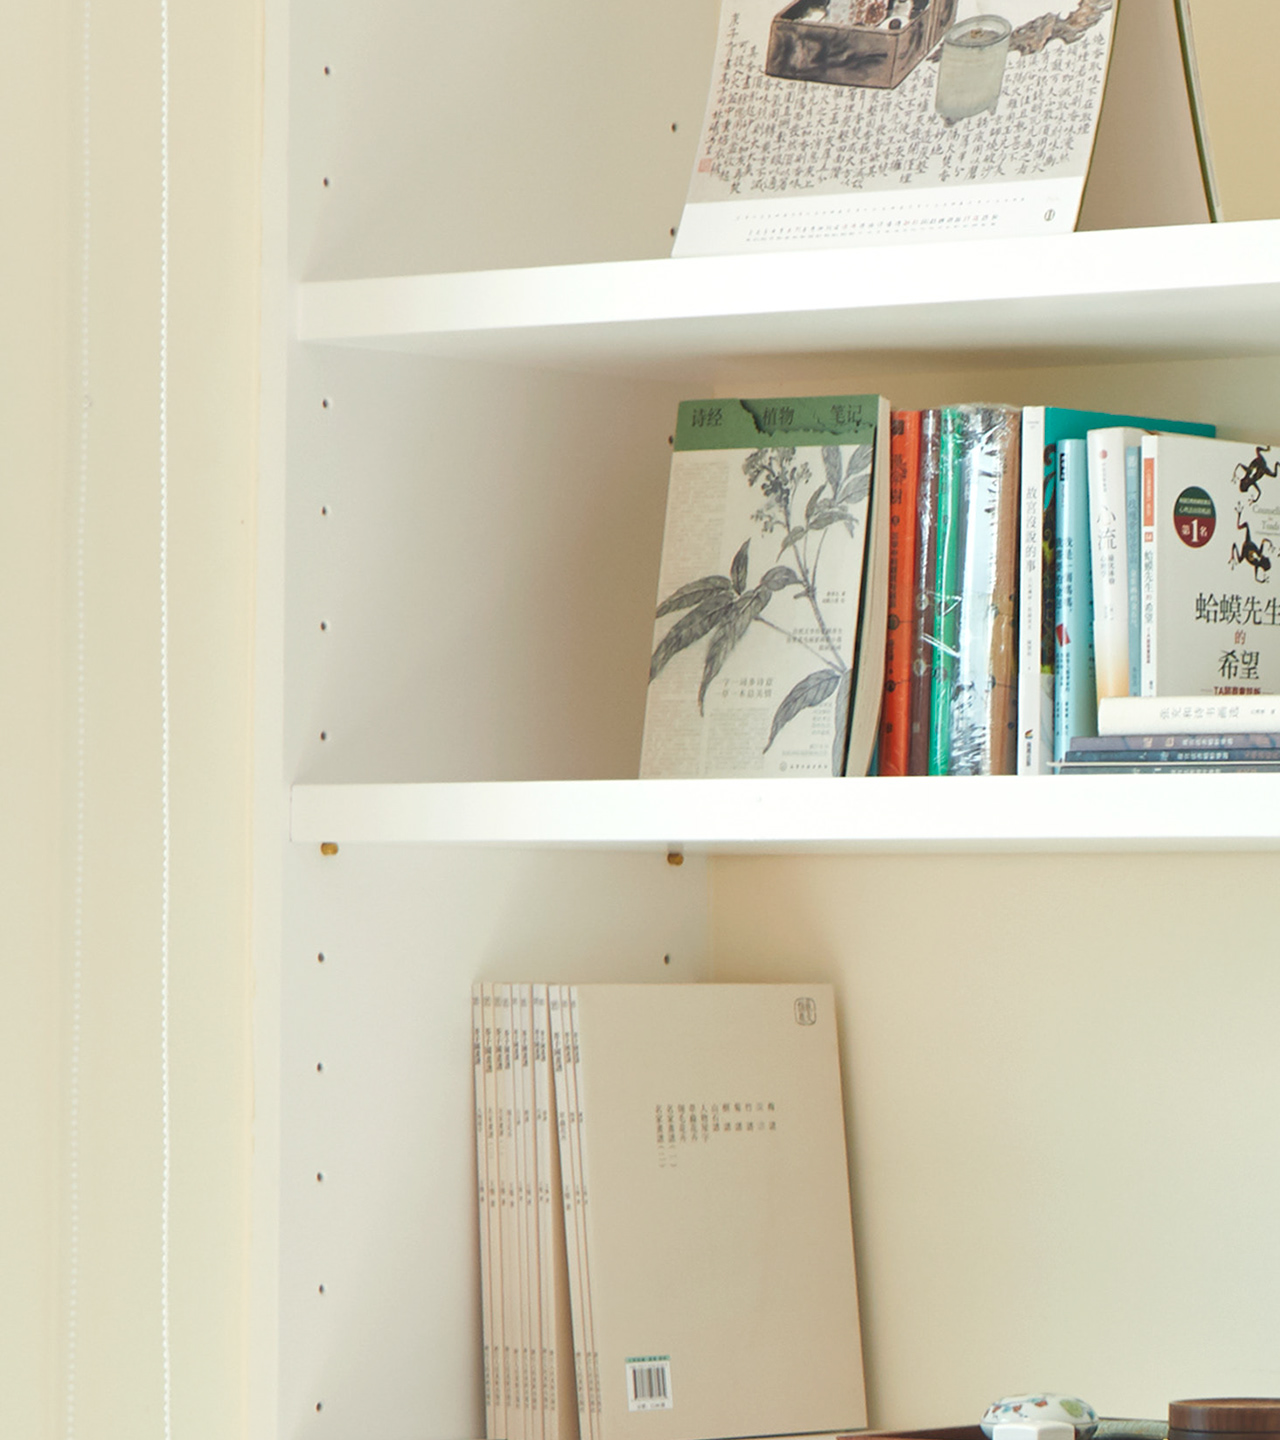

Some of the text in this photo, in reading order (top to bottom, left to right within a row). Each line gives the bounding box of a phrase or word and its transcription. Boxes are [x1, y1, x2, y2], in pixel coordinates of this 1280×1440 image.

[691, 402, 862, 428] 诗经 植物 笔记
[1096, 506, 1118, 551] 心流
[1182, 519, 1208, 544] 第1名
[1234, 629, 1247, 646] 的
[1217, 649, 1260, 681] 希望
